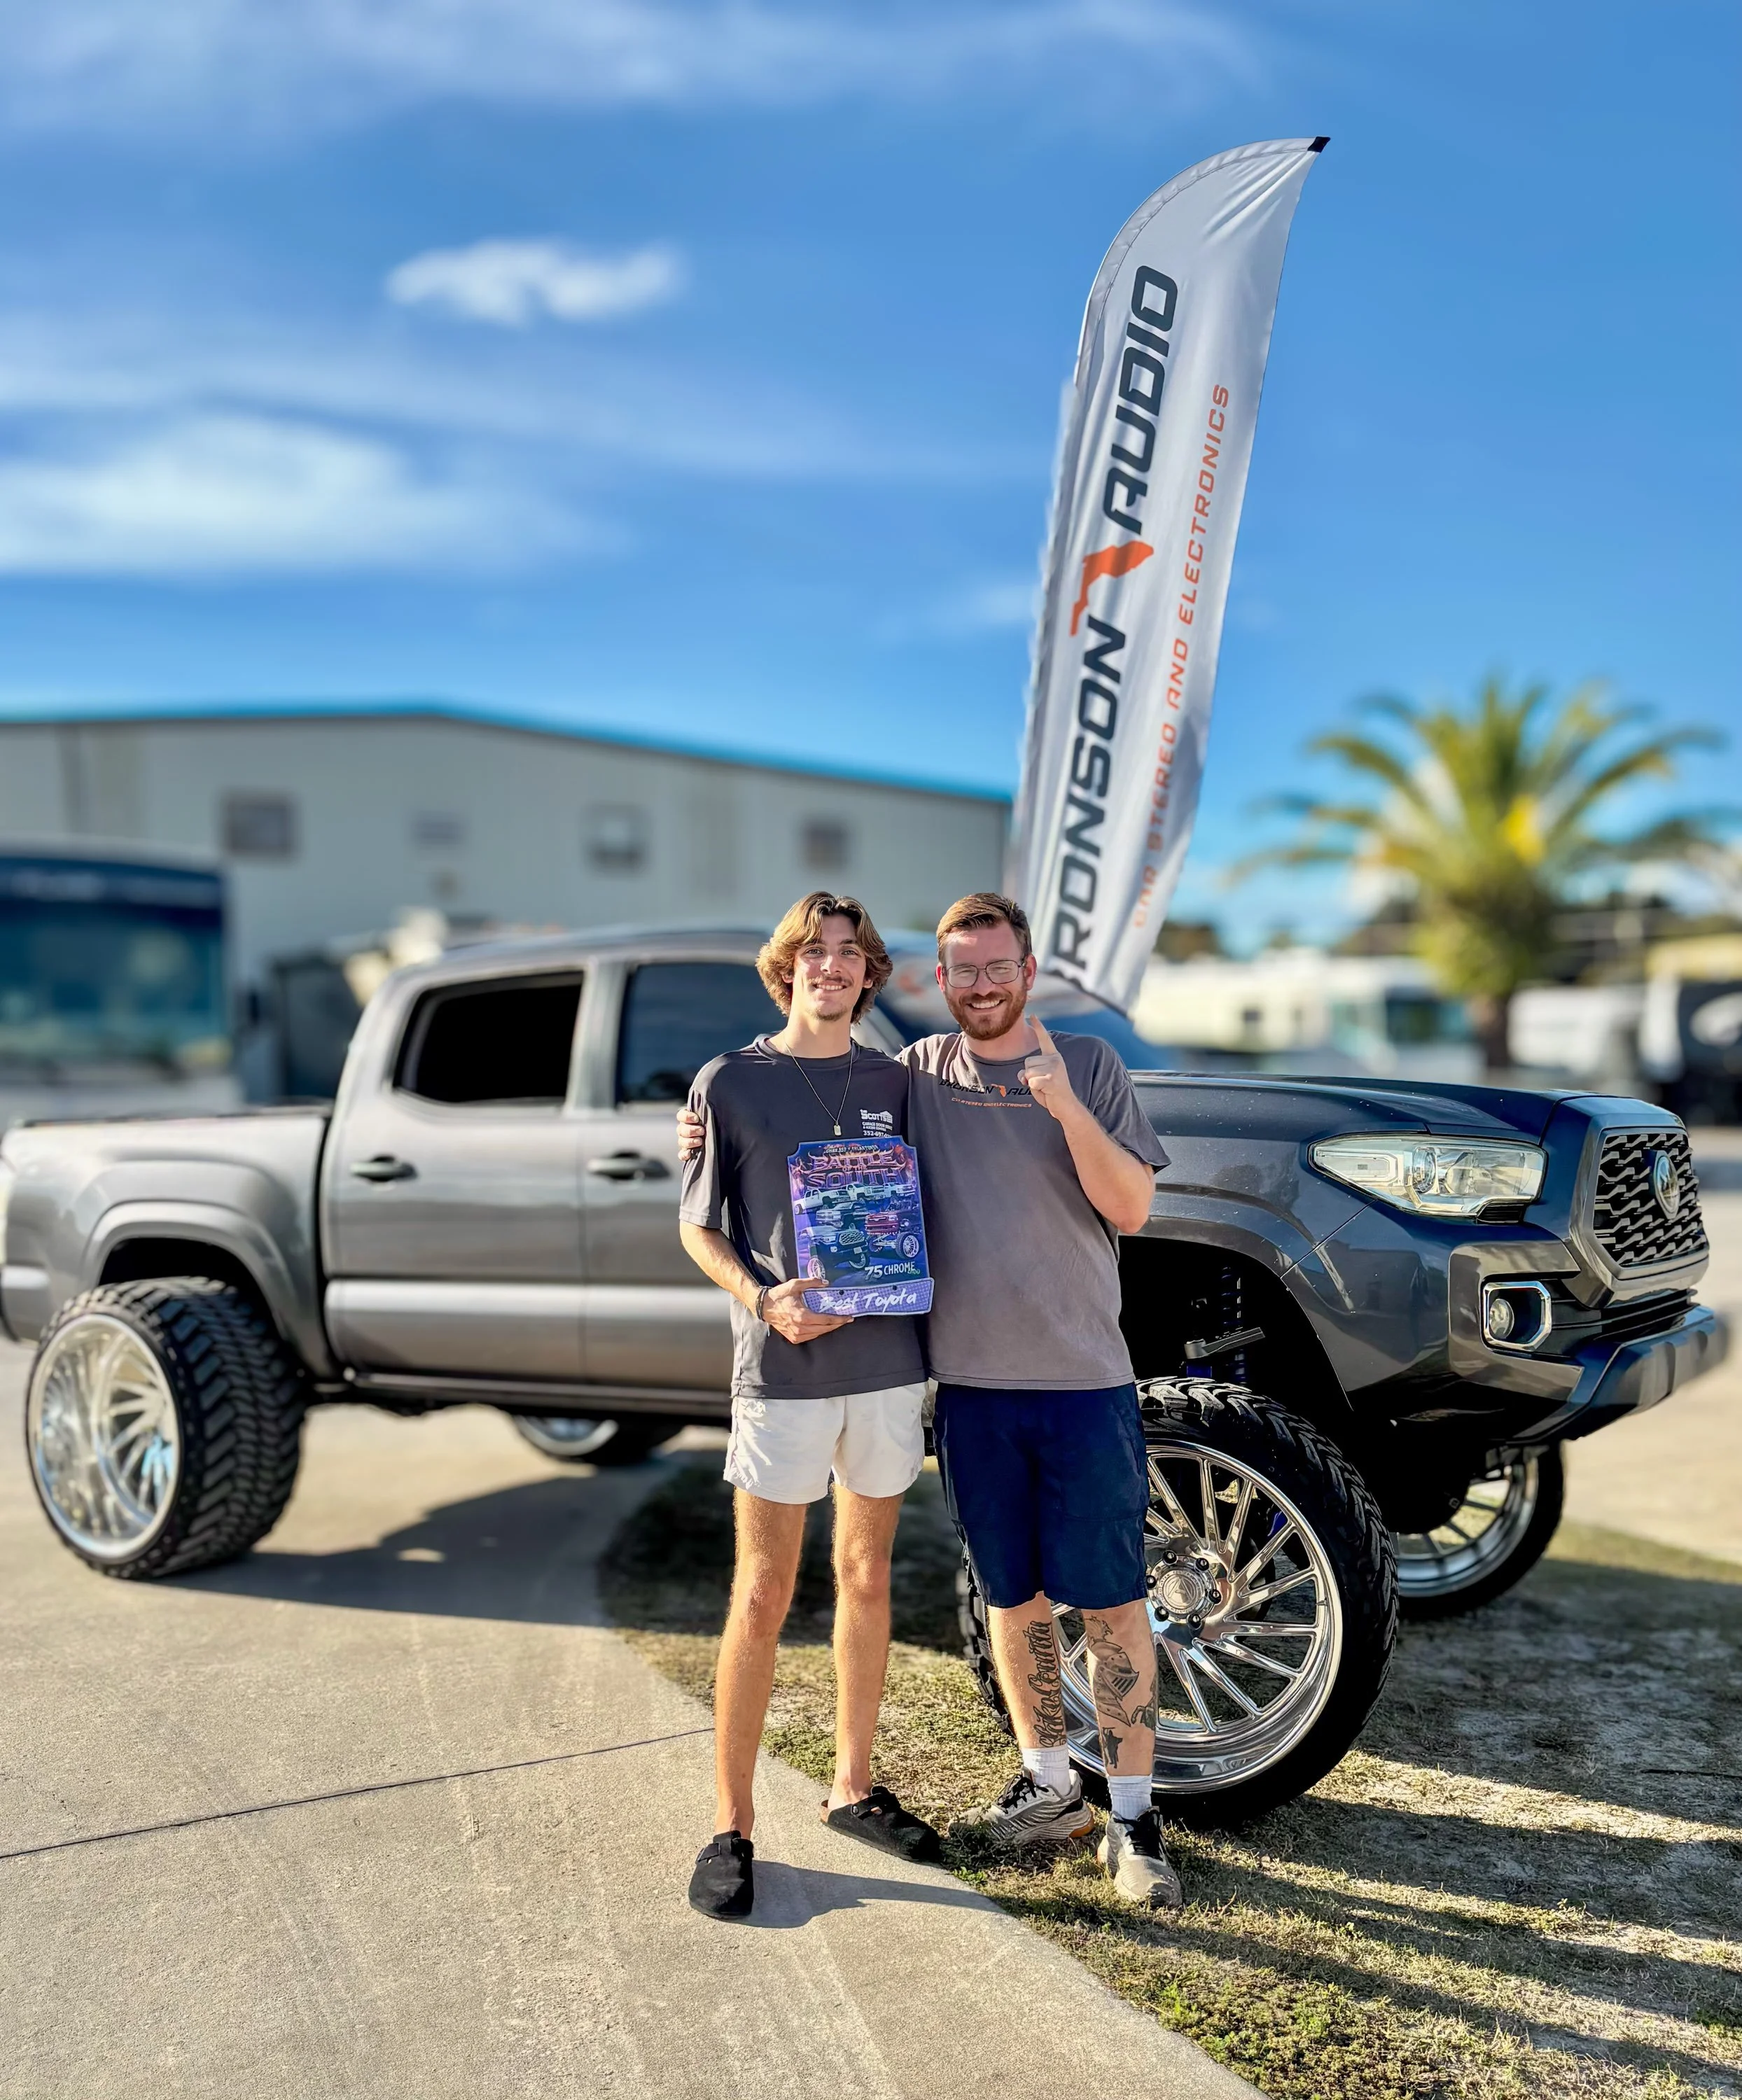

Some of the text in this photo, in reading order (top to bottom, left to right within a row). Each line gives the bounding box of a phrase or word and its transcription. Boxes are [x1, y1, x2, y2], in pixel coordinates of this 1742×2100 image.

[1049, 265, 1178, 988] RONSON AUDIO
[1147, 724, 1177, 853] STEREO
[1166, 638, 1189, 710] AND
[1178, 384, 1229, 626] ELECTRONICS
[809, 1151, 902, 1170] BATTLE
[807, 1168, 905, 1189] SOUTH
[864, 1264, 882, 1280] 75
[884, 1261, 915, 1275] CHROME
[819, 1288, 917, 1313] Best Toyota
